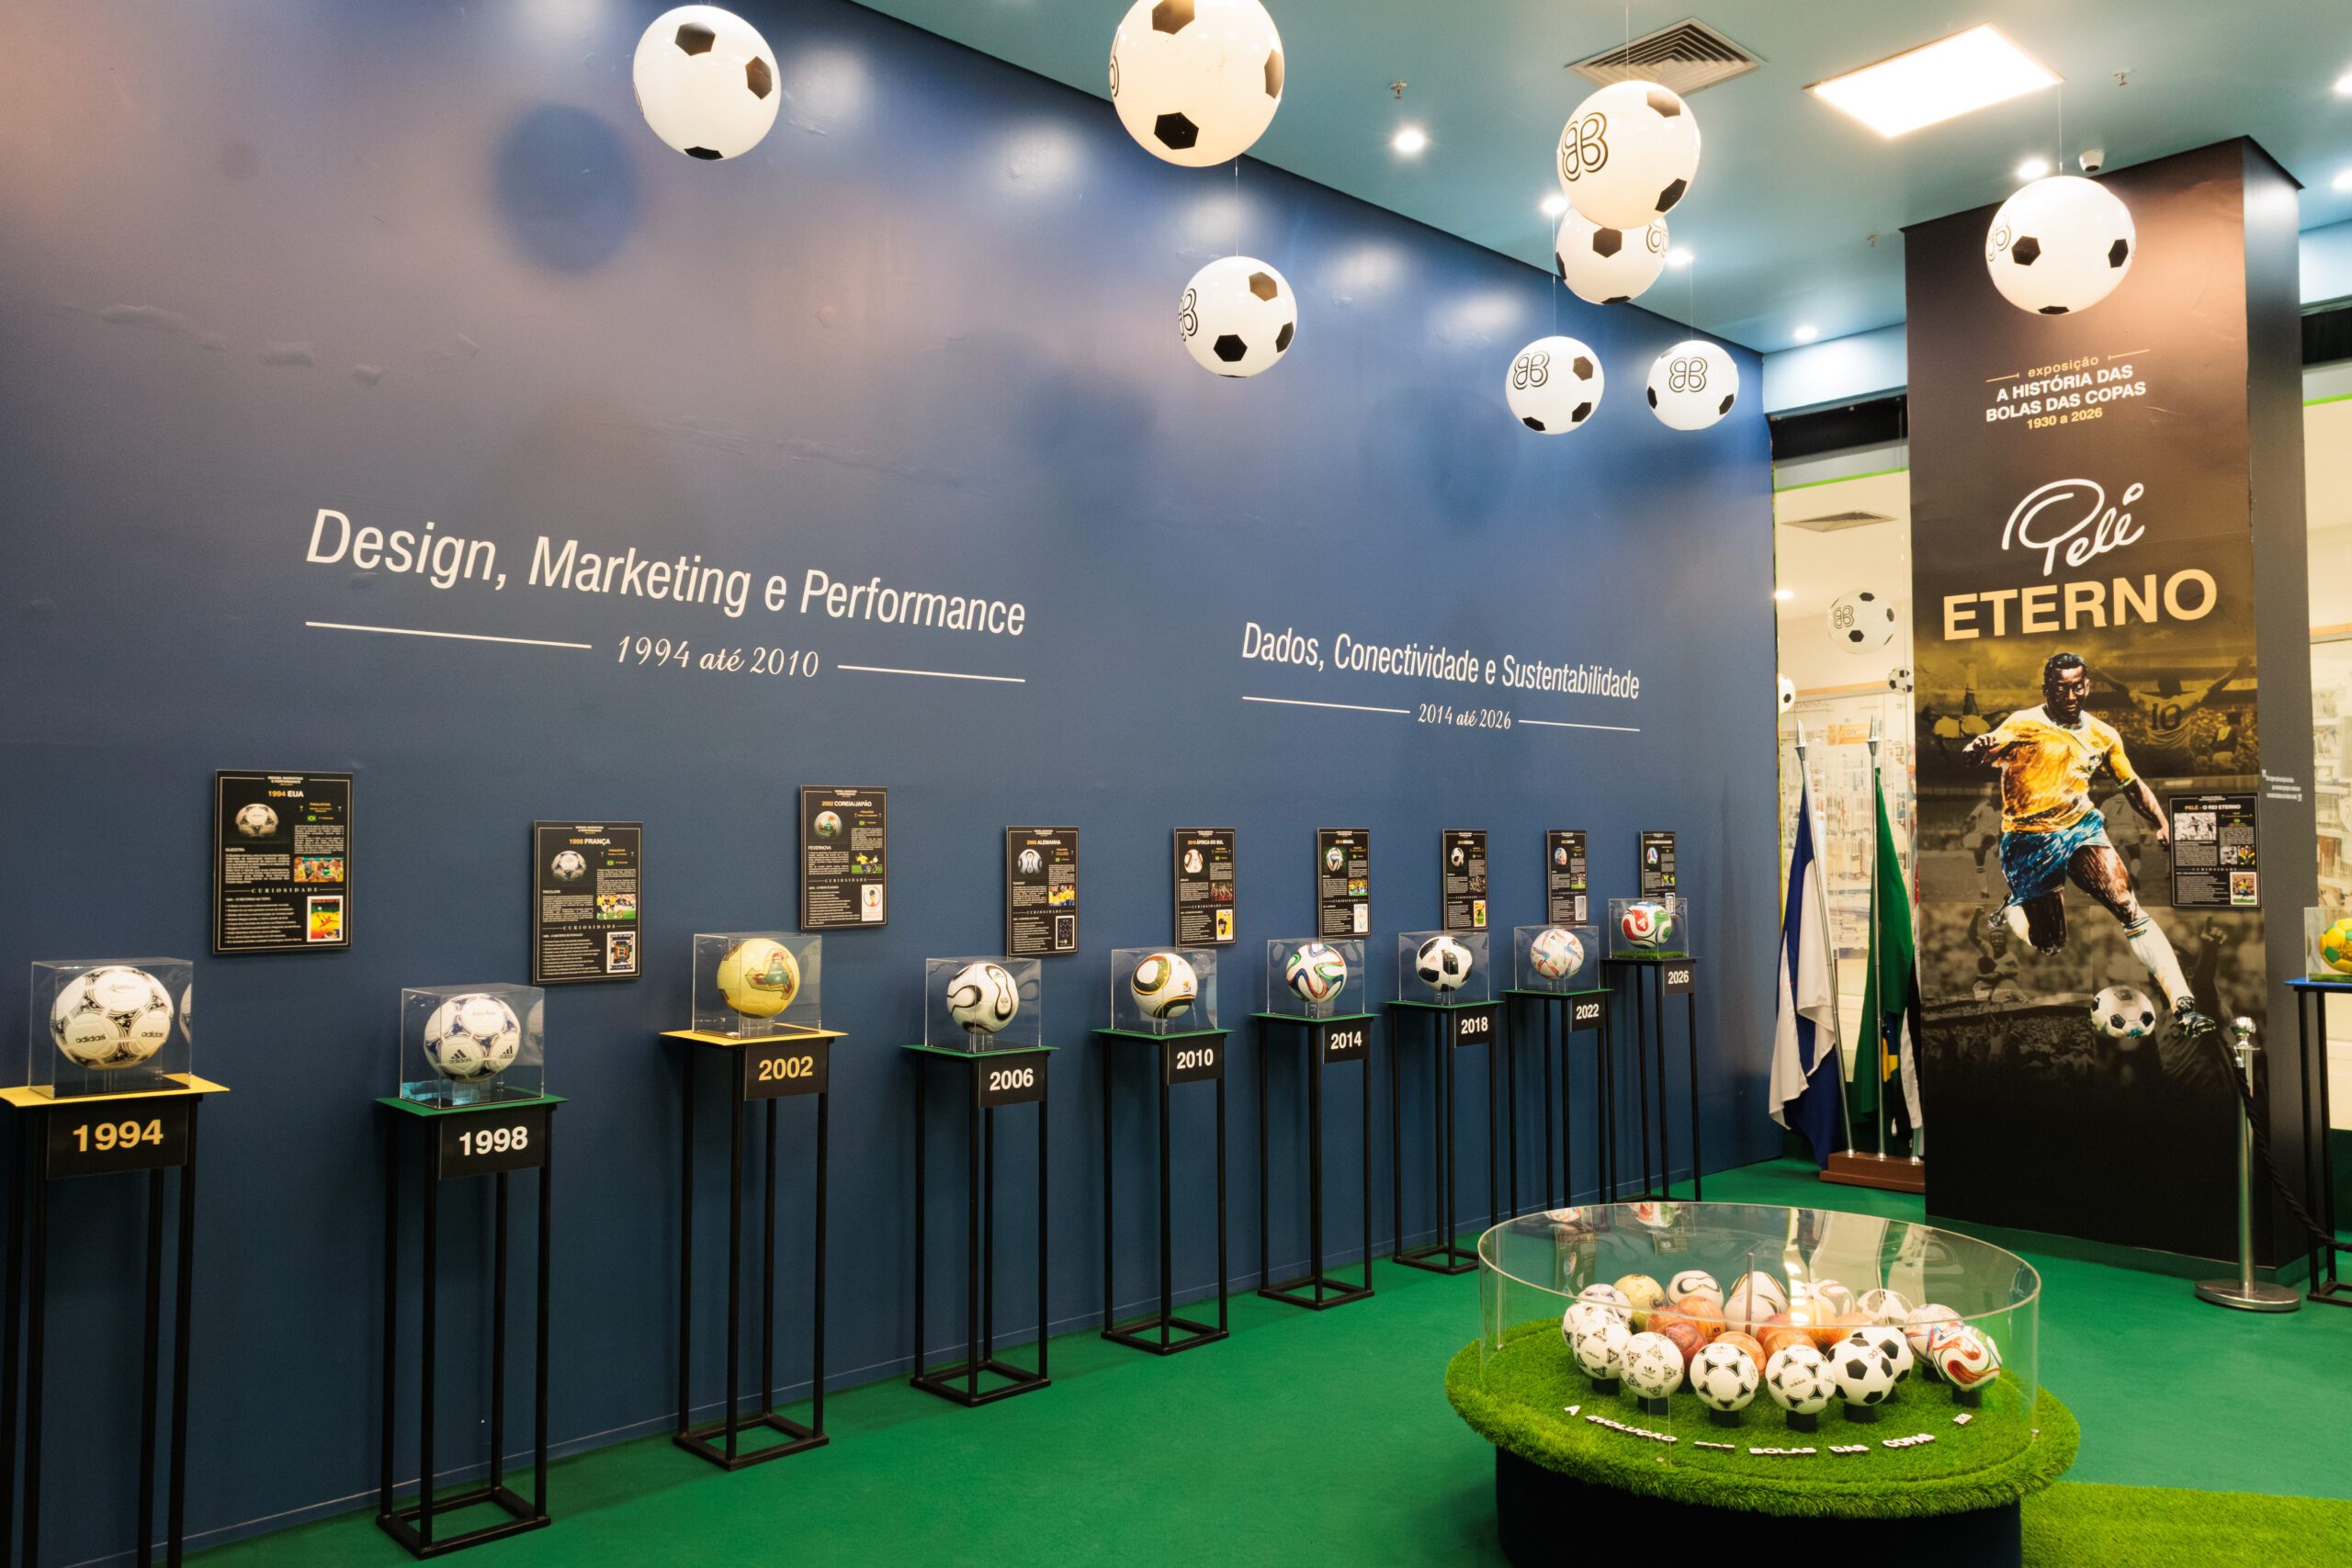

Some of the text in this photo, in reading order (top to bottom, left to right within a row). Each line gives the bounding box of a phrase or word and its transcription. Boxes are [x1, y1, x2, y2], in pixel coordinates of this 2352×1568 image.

[2028, 355, 2099, 378] exposição
[1996, 365, 2133, 401] A HISTÓRIA DAS
[1985, 381, 2146, 422] BOLAS DAS COPAS
[2027, 407, 2103, 430] 1930 a 2026
[2002, 478, 2145, 577] Pelé
[305, 508, 1026, 637] Design, Marketing e Performance
[1943, 569, 2218, 640] ETERNO
[616, 635, 820, 678] 1994 até 2010
[1241, 622, 1640, 700] Dados, Conectividade e Sustentabilidade
[1418, 704, 1512, 729] 2014 até 2026
[2152, 703, 2182, 730] 10
[584, 838, 611, 846] FRANÇA
[1668, 969, 1690, 986] 2026
[1576, 1003, 1600, 1020] 2022
[1461, 1016, 1488, 1034] 2018
[75, 1033, 107, 1043] adidas
[1330, 1031, 1363, 1050] 2014
[758, 1055, 813, 1081] 2002
[1176, 1048, 1214, 1070] 2010
[989, 1067, 1034, 1091] 2006
[73, 1119, 164, 1152] 1994
[458, 1125, 528, 1156] 1998
[1564, 1405, 1580, 1416] A
